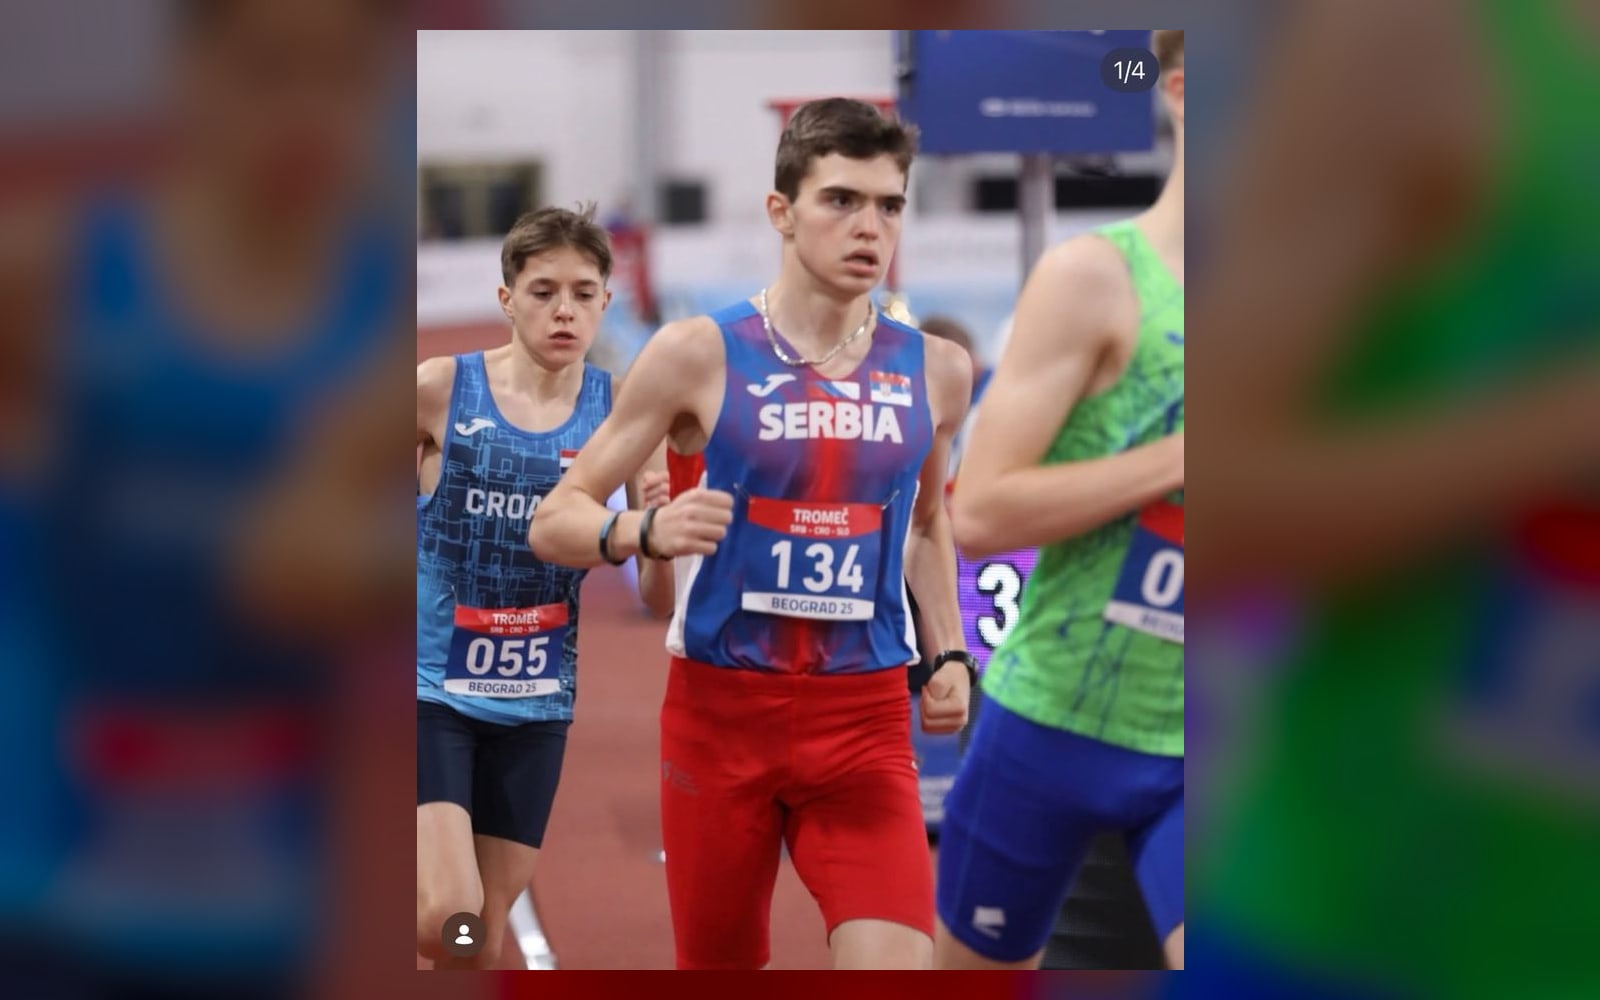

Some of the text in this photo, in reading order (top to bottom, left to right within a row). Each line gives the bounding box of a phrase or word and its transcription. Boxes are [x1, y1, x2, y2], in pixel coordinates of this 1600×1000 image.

[758, 401, 904, 444] SERBIA
[792, 507, 849, 525] TROMEČ
[771, 540, 864, 593] 134
[771, 597, 853, 614] BEOGRAD 25
[977, 562, 1022, 649] 3
[466, 636, 549, 677] 055
[468, 681, 537, 694] BEOGRAD 25
